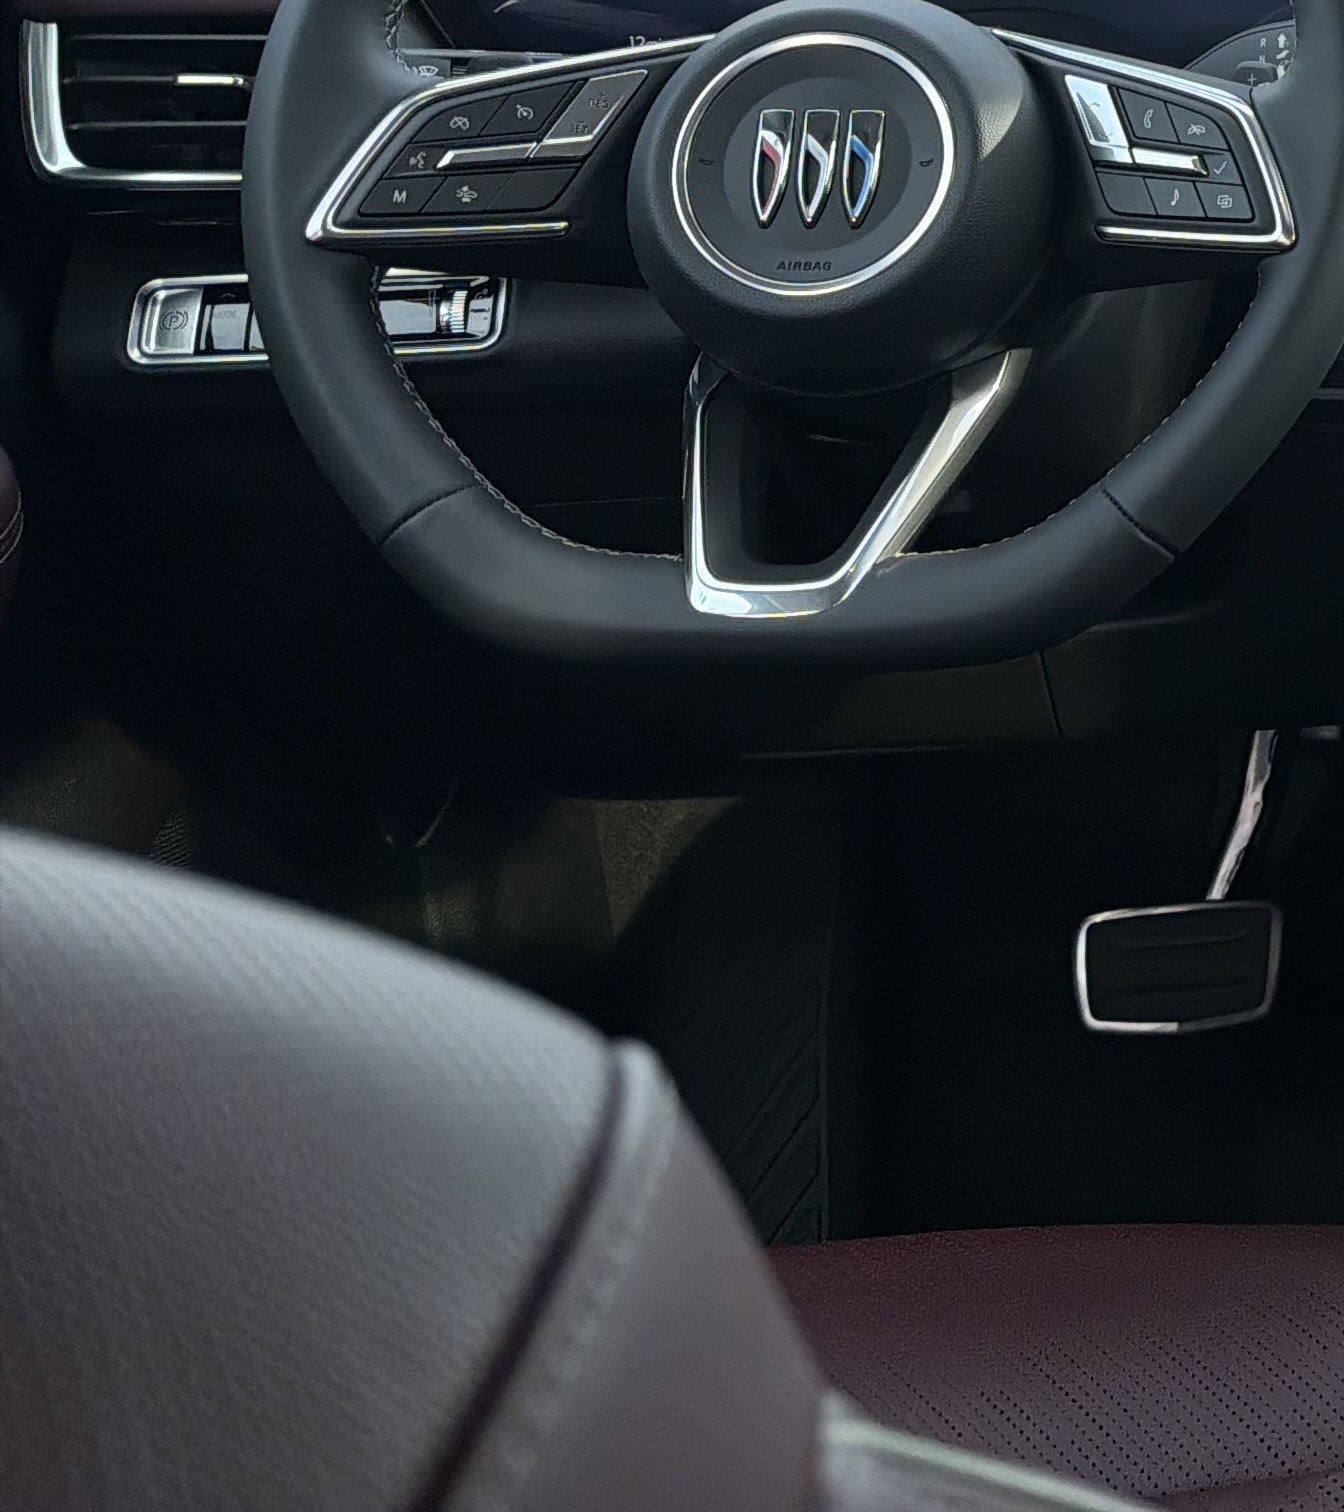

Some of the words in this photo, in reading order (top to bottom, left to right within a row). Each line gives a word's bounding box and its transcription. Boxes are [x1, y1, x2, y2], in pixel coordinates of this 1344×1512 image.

[1260, 38, 1267, 48] R
[392, 189, 407, 204] M
[776, 261, 832, 271] AIRBAG
